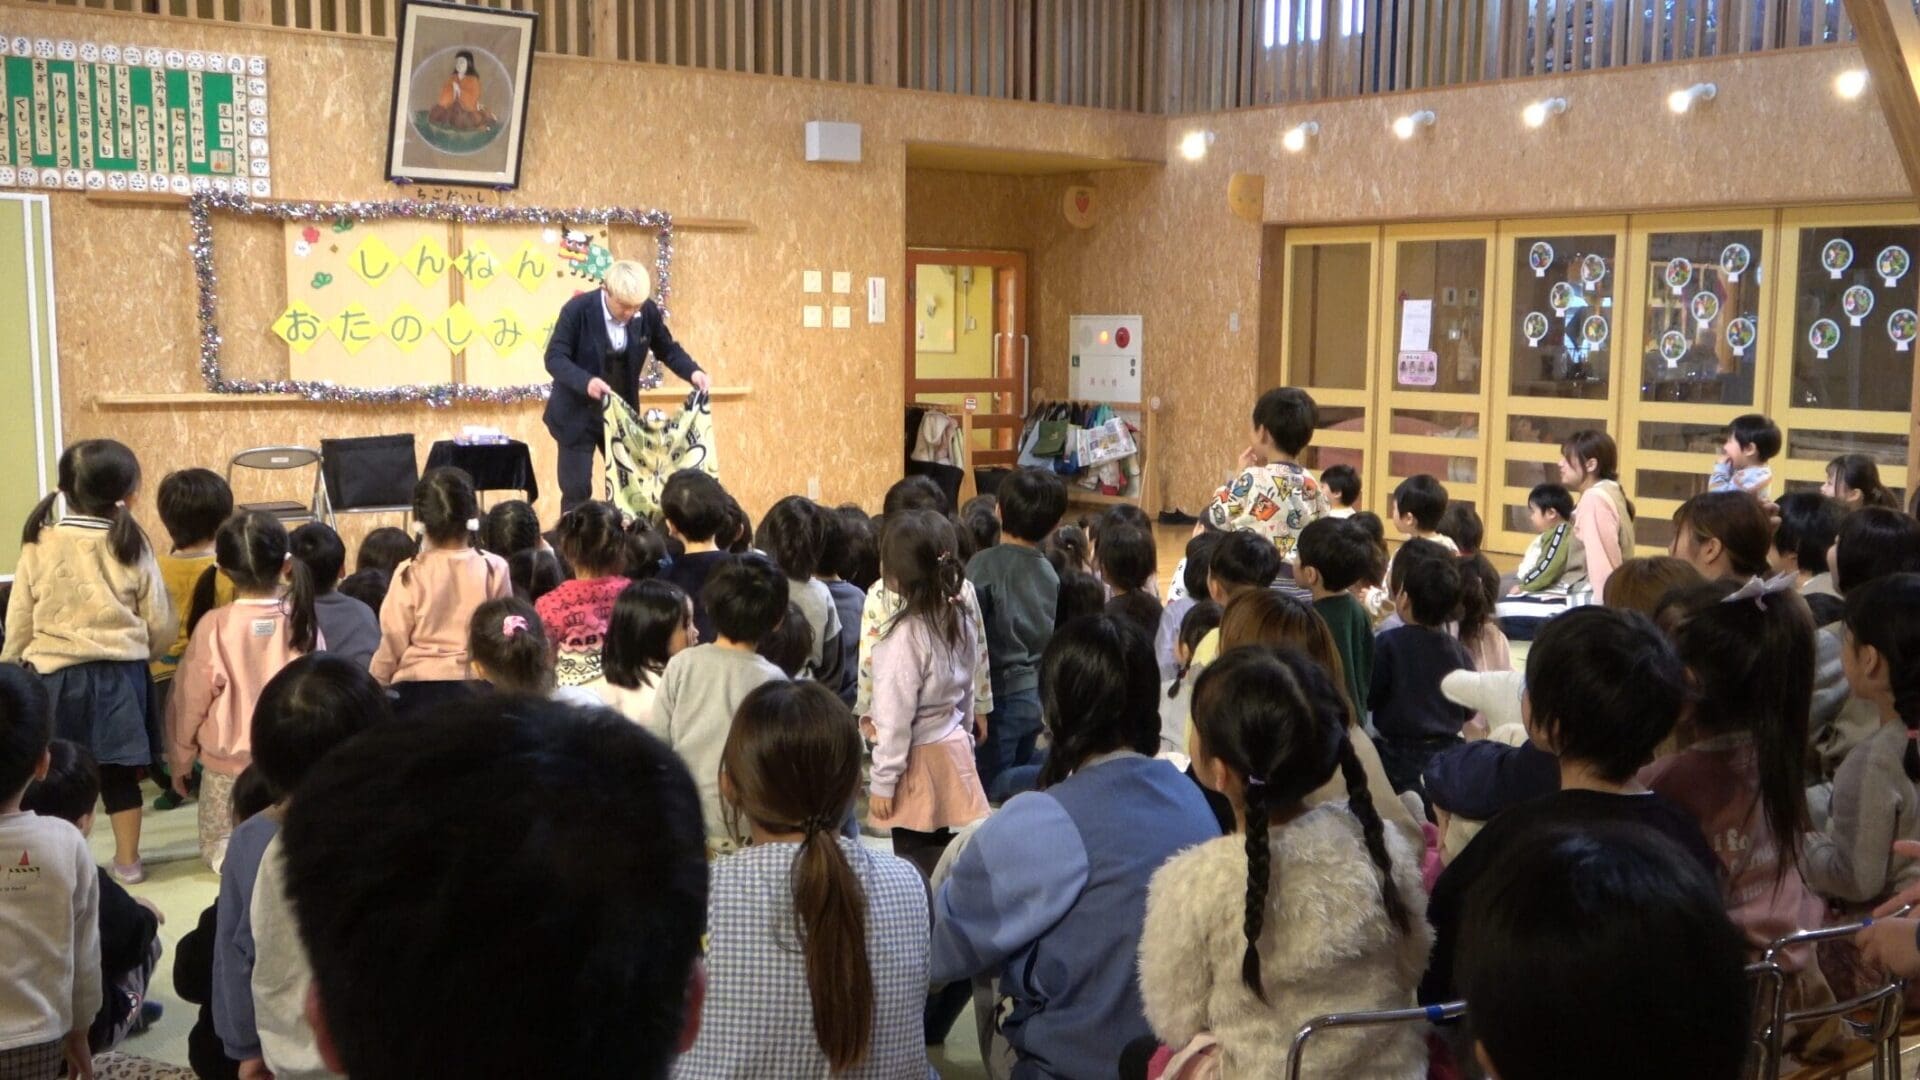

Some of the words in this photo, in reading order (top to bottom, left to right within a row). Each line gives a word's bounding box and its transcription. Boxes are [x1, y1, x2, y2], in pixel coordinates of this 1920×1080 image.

[417, 187, 484, 203] ちごだいし
[360, 244, 544, 280] しんねん
